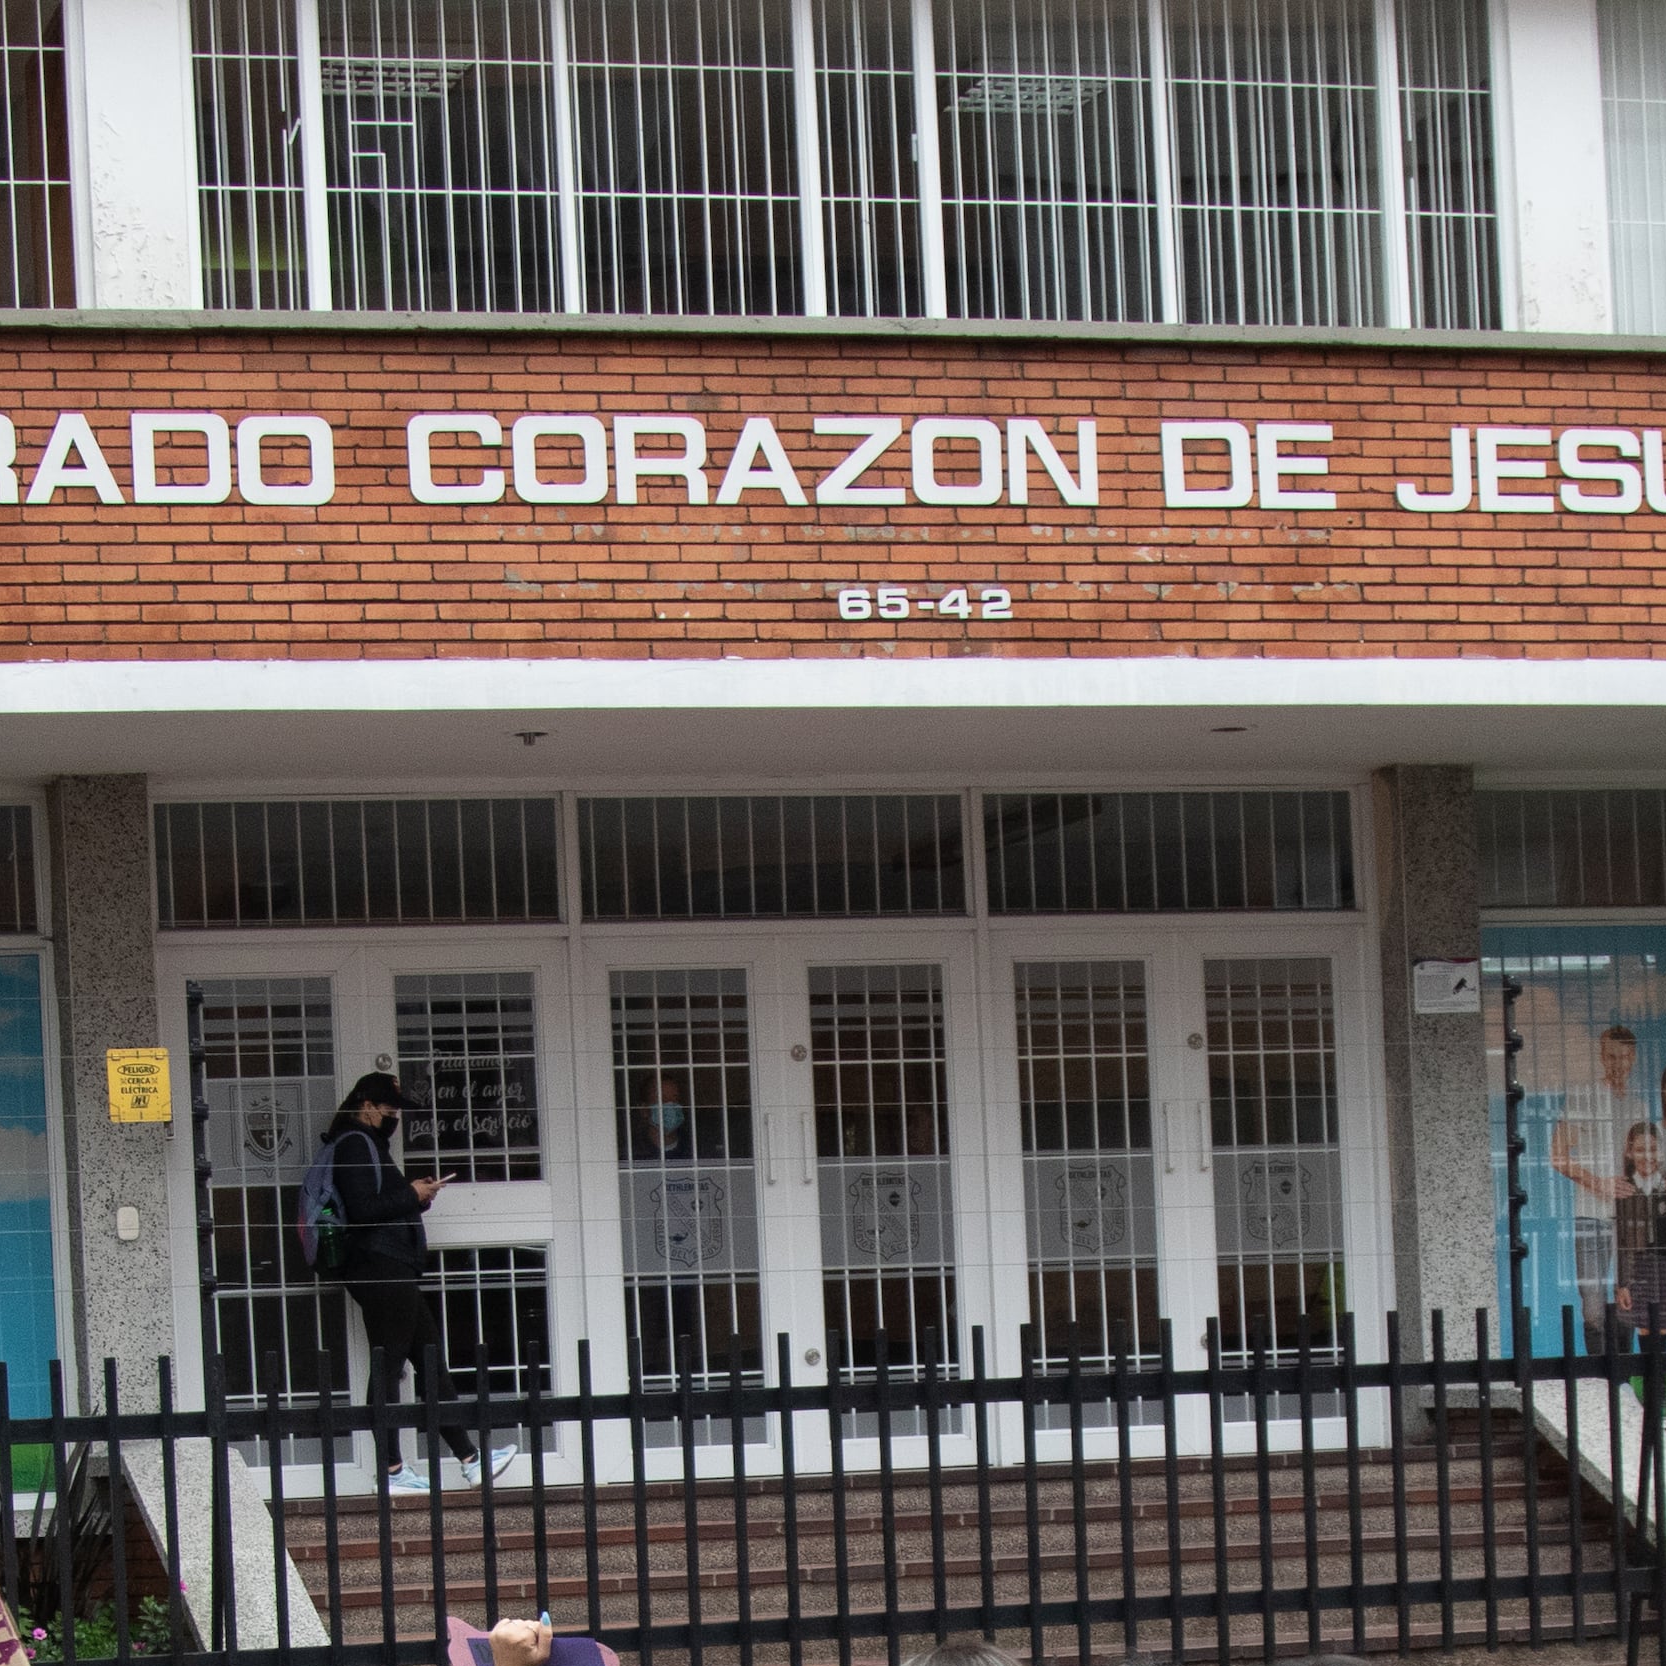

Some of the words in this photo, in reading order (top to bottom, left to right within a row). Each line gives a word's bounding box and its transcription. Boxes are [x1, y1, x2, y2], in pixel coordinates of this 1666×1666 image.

[407, 415, 1098, 507] CORAZON
[1161, 422, 1336, 509] DE
[839, 584, 1012, 619] 65-42
[123, 1066, 155, 1075] PELIGRO
[127, 1077, 151, 1085] CERCA
